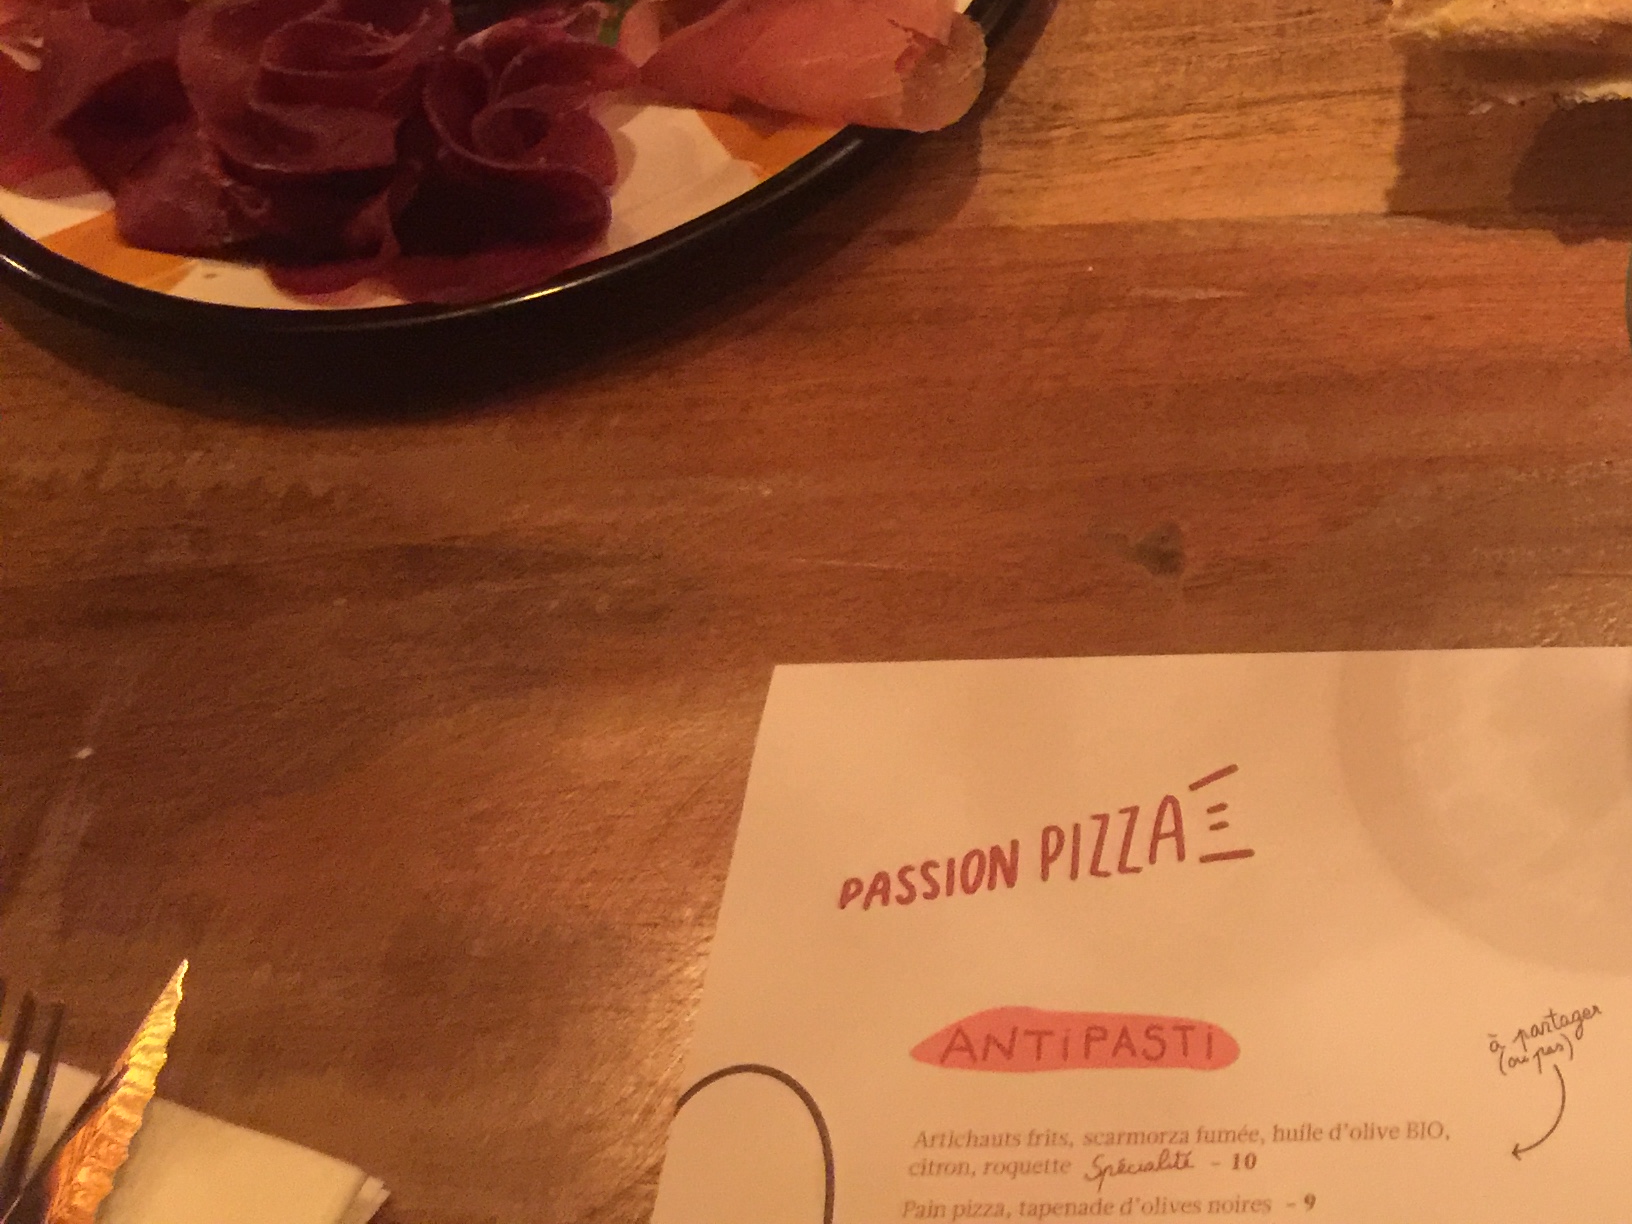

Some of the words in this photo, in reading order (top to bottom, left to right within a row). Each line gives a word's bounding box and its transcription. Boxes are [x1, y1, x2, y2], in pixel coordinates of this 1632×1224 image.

[837, 838, 1021, 911] PASSION
[1040, 793, 1188, 882] PIZZA
[1512, 1004, 1602, 1053] partager
[1532, 1032, 1574, 1075] pas)
[913, 1128, 1021, 1150] Artichauts
[1026, 1128, 1073, 1150] frits,
[1081, 1126, 1190, 1148] scarmorza
[1195, 1124, 1265, 1146] fumée,
[1271, 1122, 1324, 1144] huile
[1328, 1121, 1400, 1143] d'olive
[1405, 1119, 1451, 1143] BIO,
[907, 1157, 977, 1178] citron,
[981, 1158, 1073, 1181] roquette
[1231, 1151, 1258, 1171] 10
[901, 1198, 947, 1219] Pain
[952, 1198, 1013, 1223] pizza,
[1018, 1196, 1114, 1222] tapenade
[1119, 1194, 1202, 1217] d'olives
[1206, 1194, 1273, 1216] noires
[1303, 1191, 1318, 1213] 9
